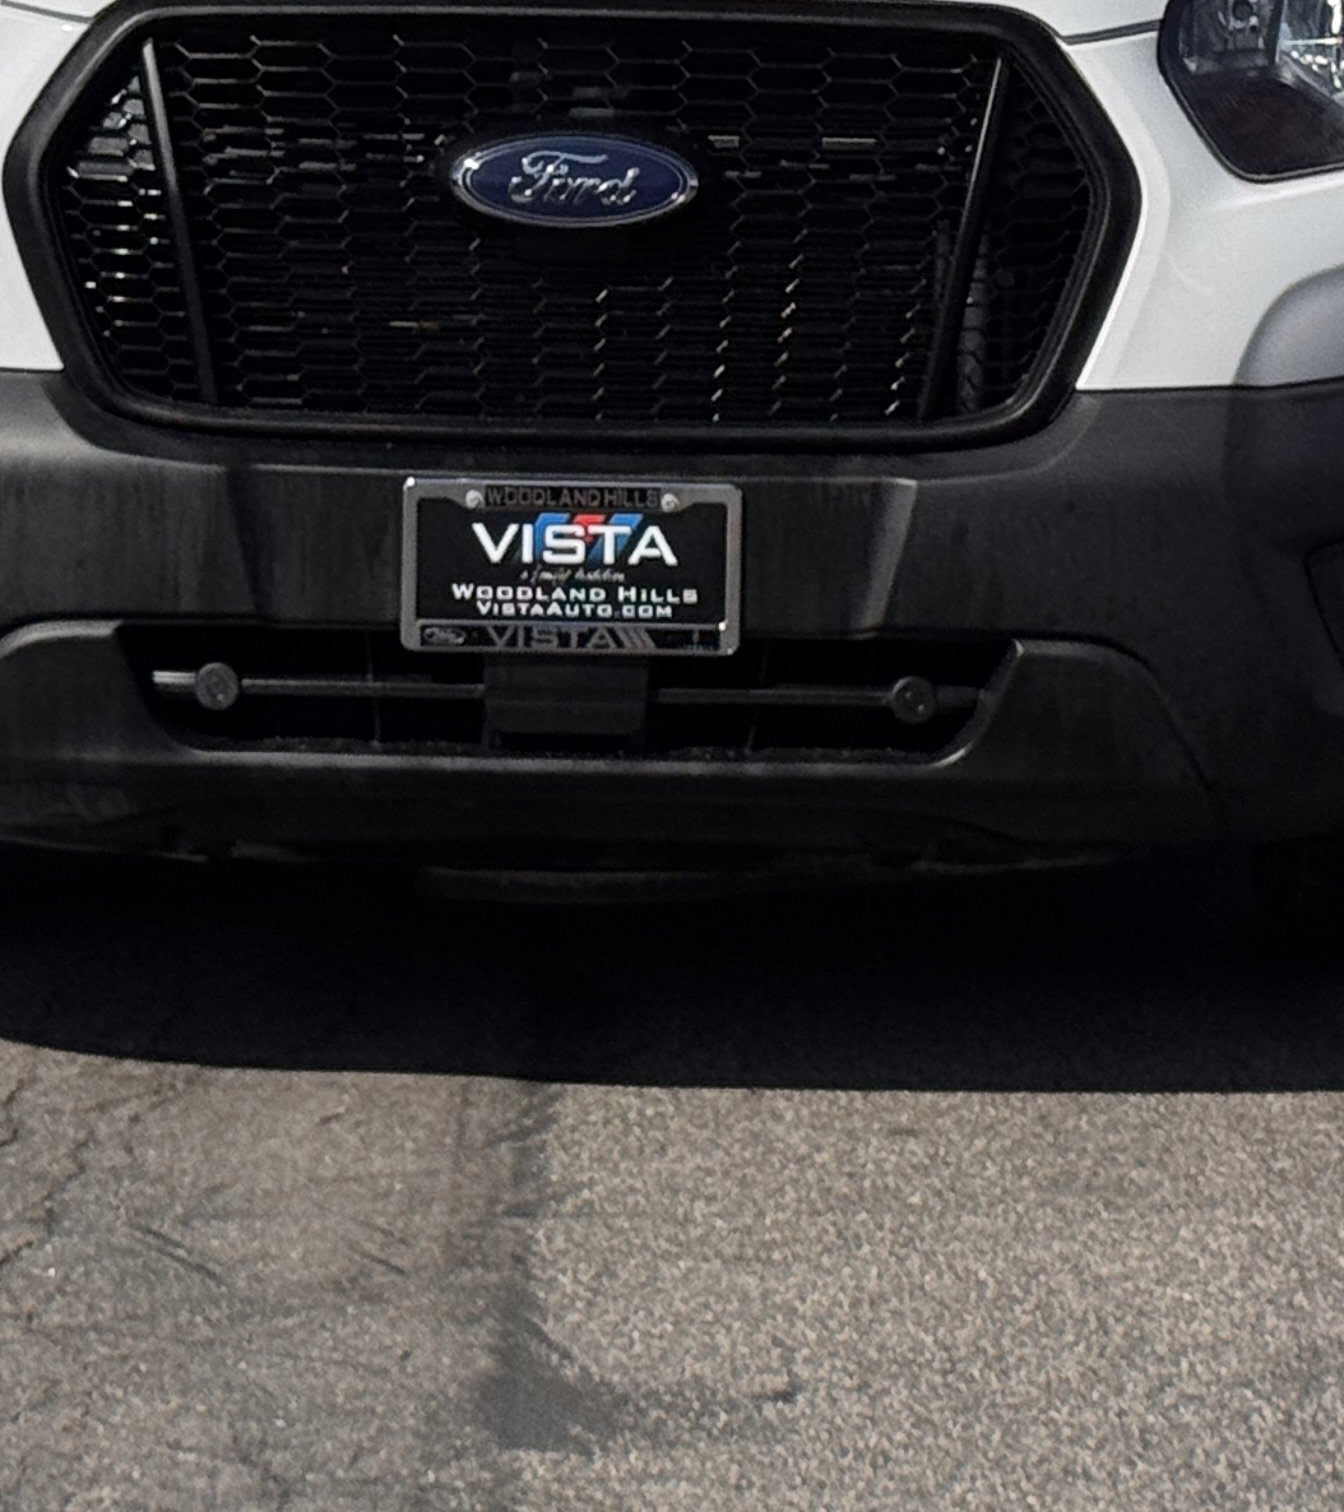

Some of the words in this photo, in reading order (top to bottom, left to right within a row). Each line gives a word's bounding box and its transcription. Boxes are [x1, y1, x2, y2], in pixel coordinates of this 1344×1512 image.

[508, 150, 640, 205] Ford
[471, 522, 678, 566] VISTA
[486, 626, 619, 650] VISTA
